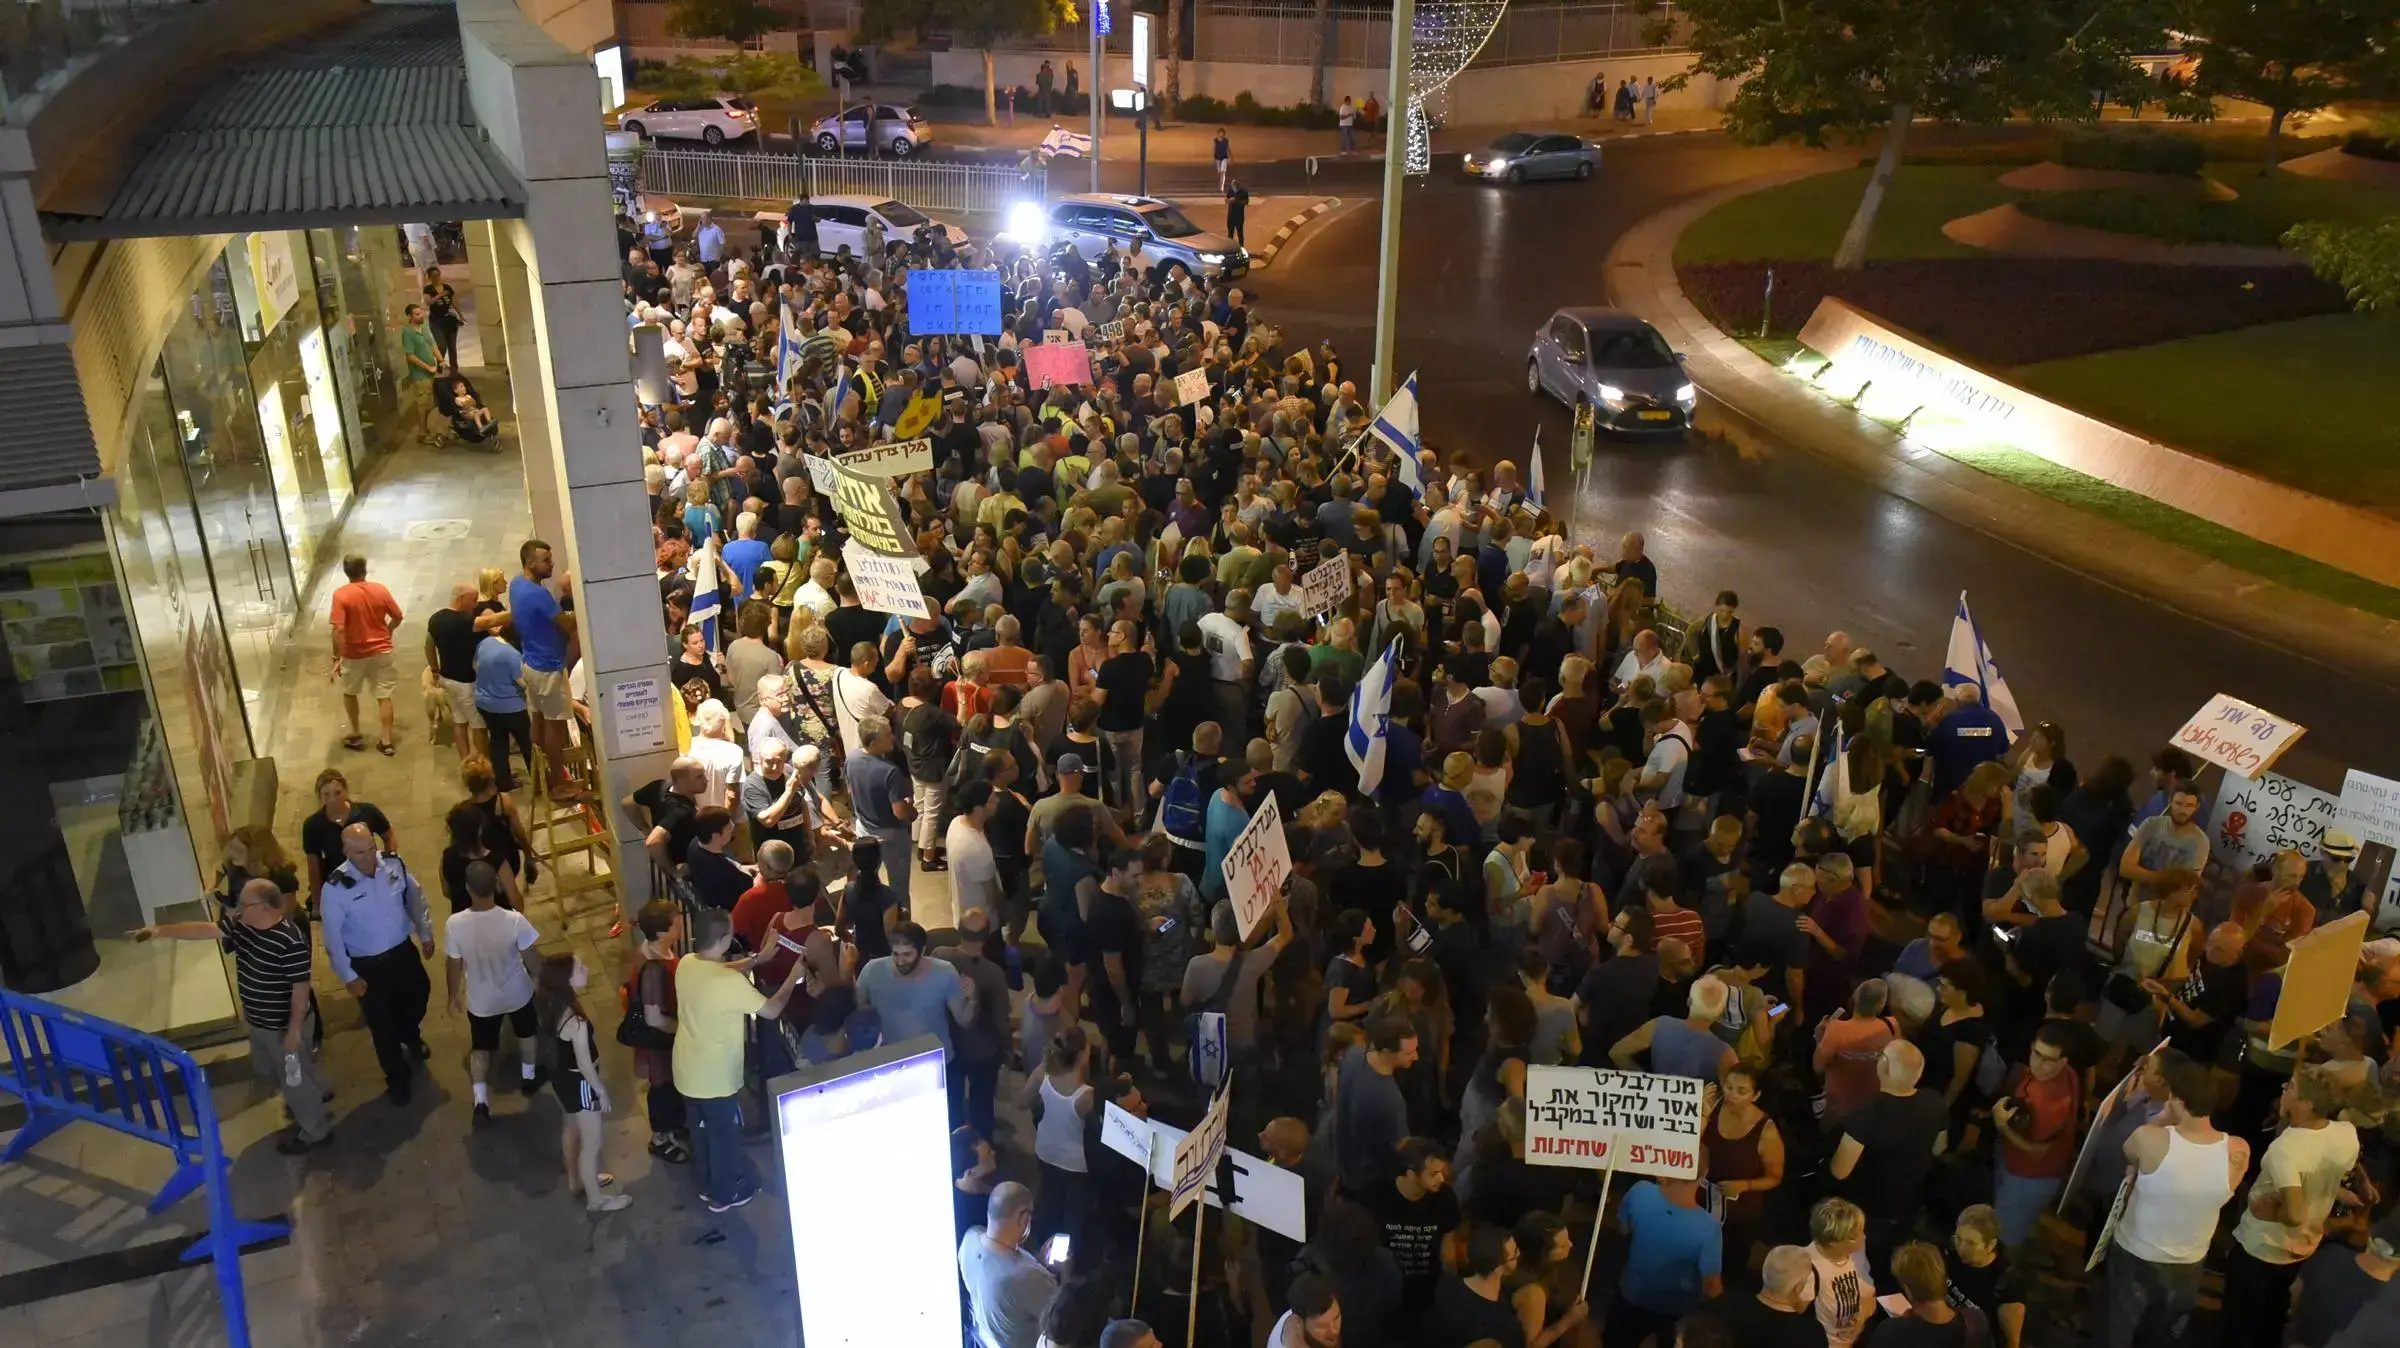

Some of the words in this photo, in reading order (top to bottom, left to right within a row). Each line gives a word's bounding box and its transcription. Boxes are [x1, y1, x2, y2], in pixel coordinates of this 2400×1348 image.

[839, 452, 872, 467] עבדים
[873, 446, 899, 462] צריך
[901, 440, 929, 459] מלך
[2251, 718, 2278, 740] עד
[2225, 789, 2258, 813] את
[1226, 804, 1277, 881] מנדלבליט
[2266, 826, 2318, 858] ישראל
[1594, 1071, 1697, 1095] מנדלבליט
[1546, 1088, 1579, 1105] את
[1587, 1090, 1648, 1113] לחקור
[1657, 1098, 1699, 1117] אסר
[1529, 1100, 1598, 1131] במקביל
[1603, 1111, 1655, 1130] ושרה
[1659, 1117, 1698, 1136] ביבי
[1531, 1136, 1608, 1158] שחיתות
[1630, 1144, 1694, 1169] משת"פ
